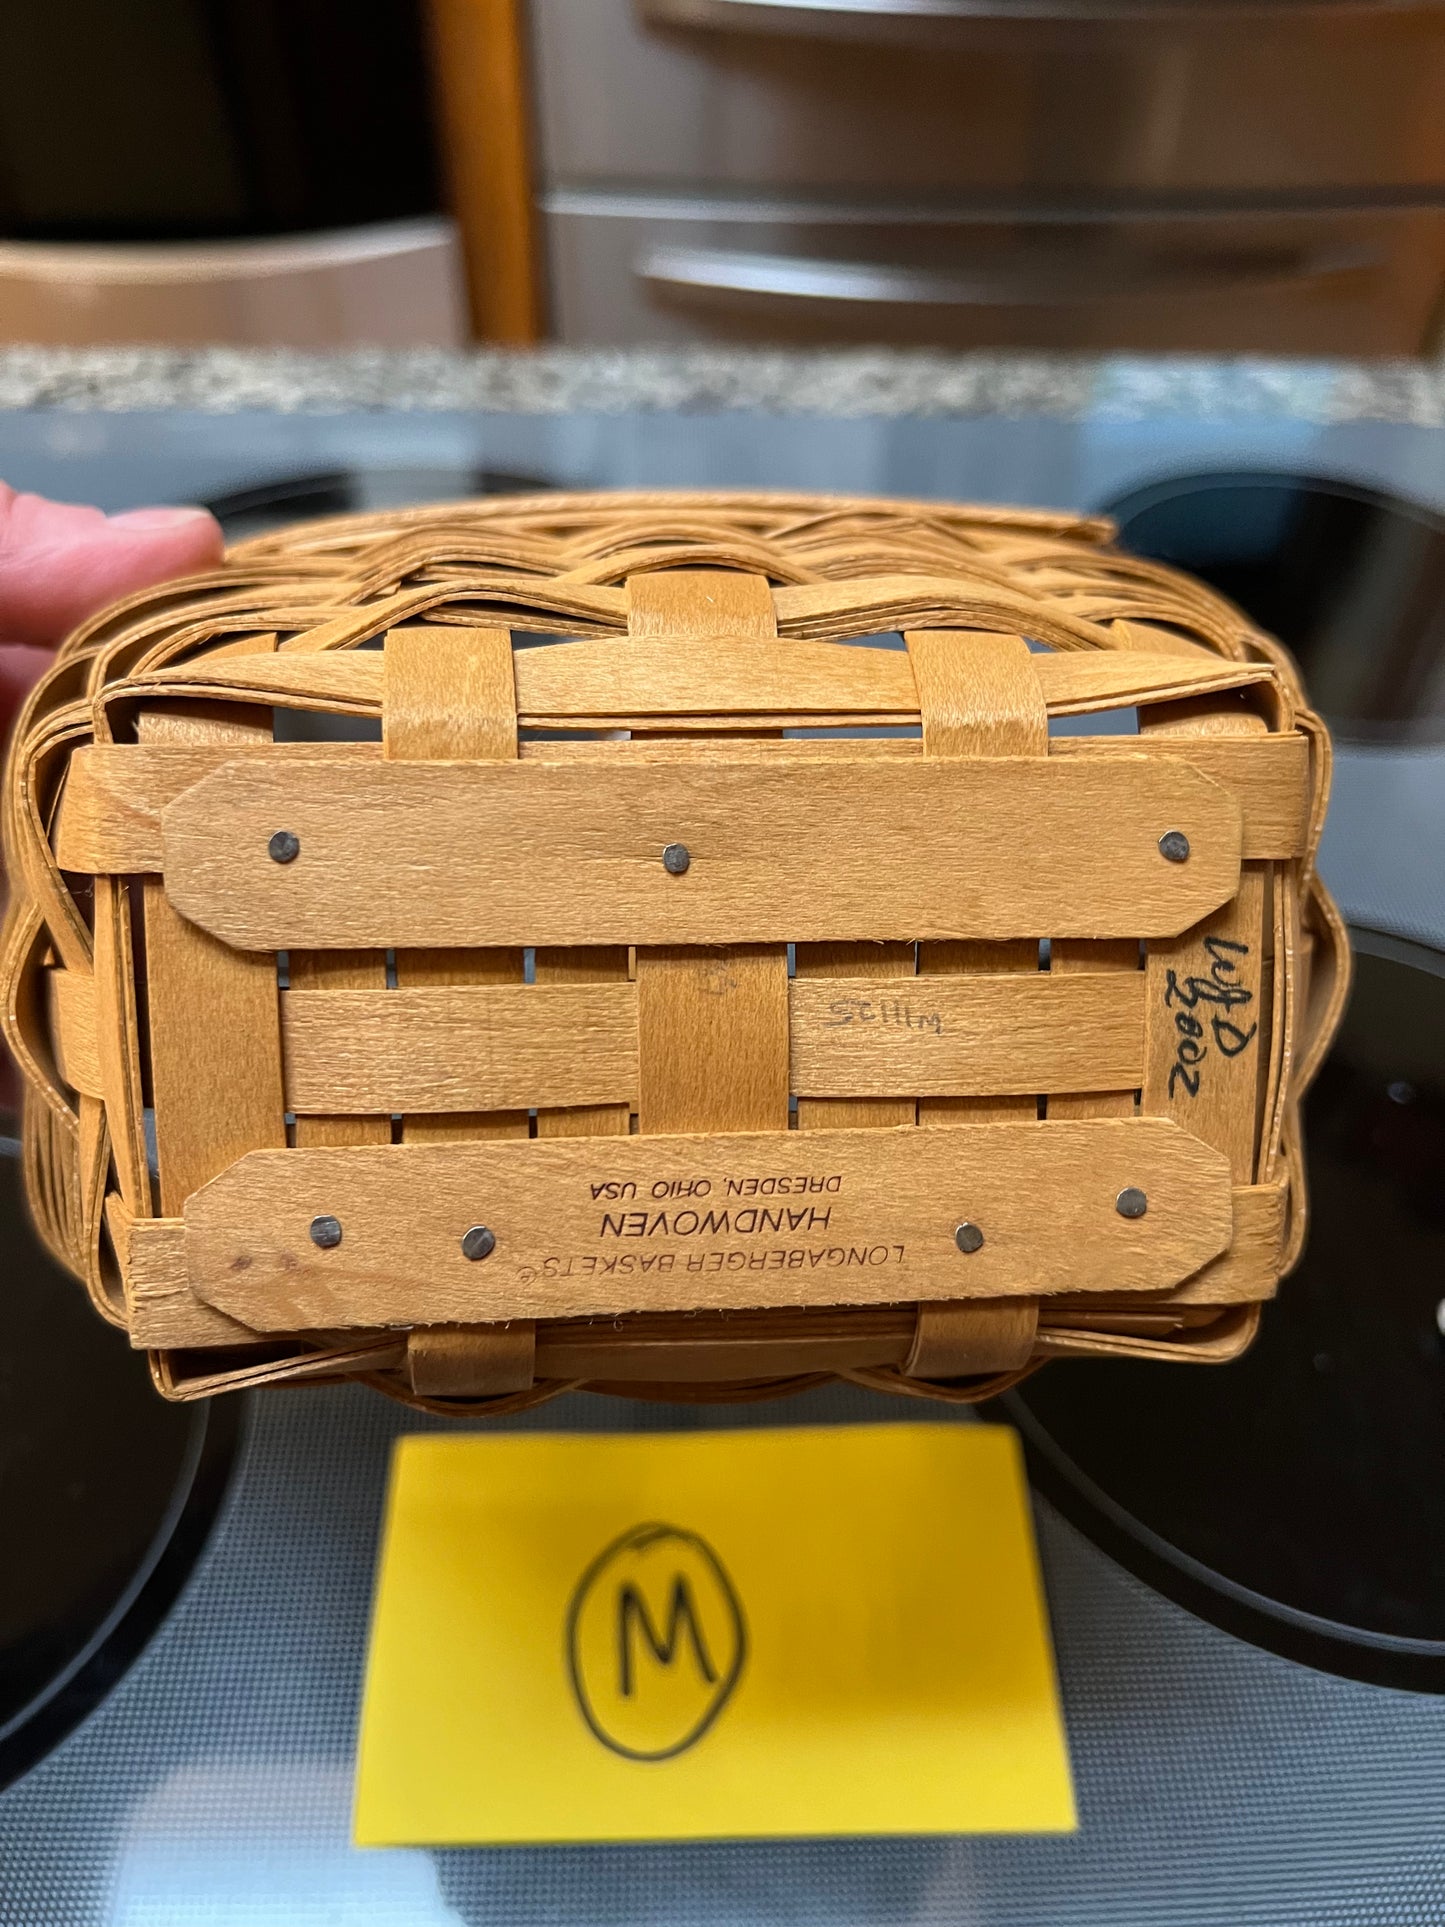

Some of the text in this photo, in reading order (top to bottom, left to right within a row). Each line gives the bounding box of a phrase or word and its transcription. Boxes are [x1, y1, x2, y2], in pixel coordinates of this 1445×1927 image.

[1164, 968, 1208, 1099] 2002
[590, 1175, 842, 1200] DRESDEN, OHIO USA
[600, 1206, 832, 1238] HANDWOVEN
[687, 1245, 905, 1273] LONGABERGER
[618, 1574, 716, 1697] M
